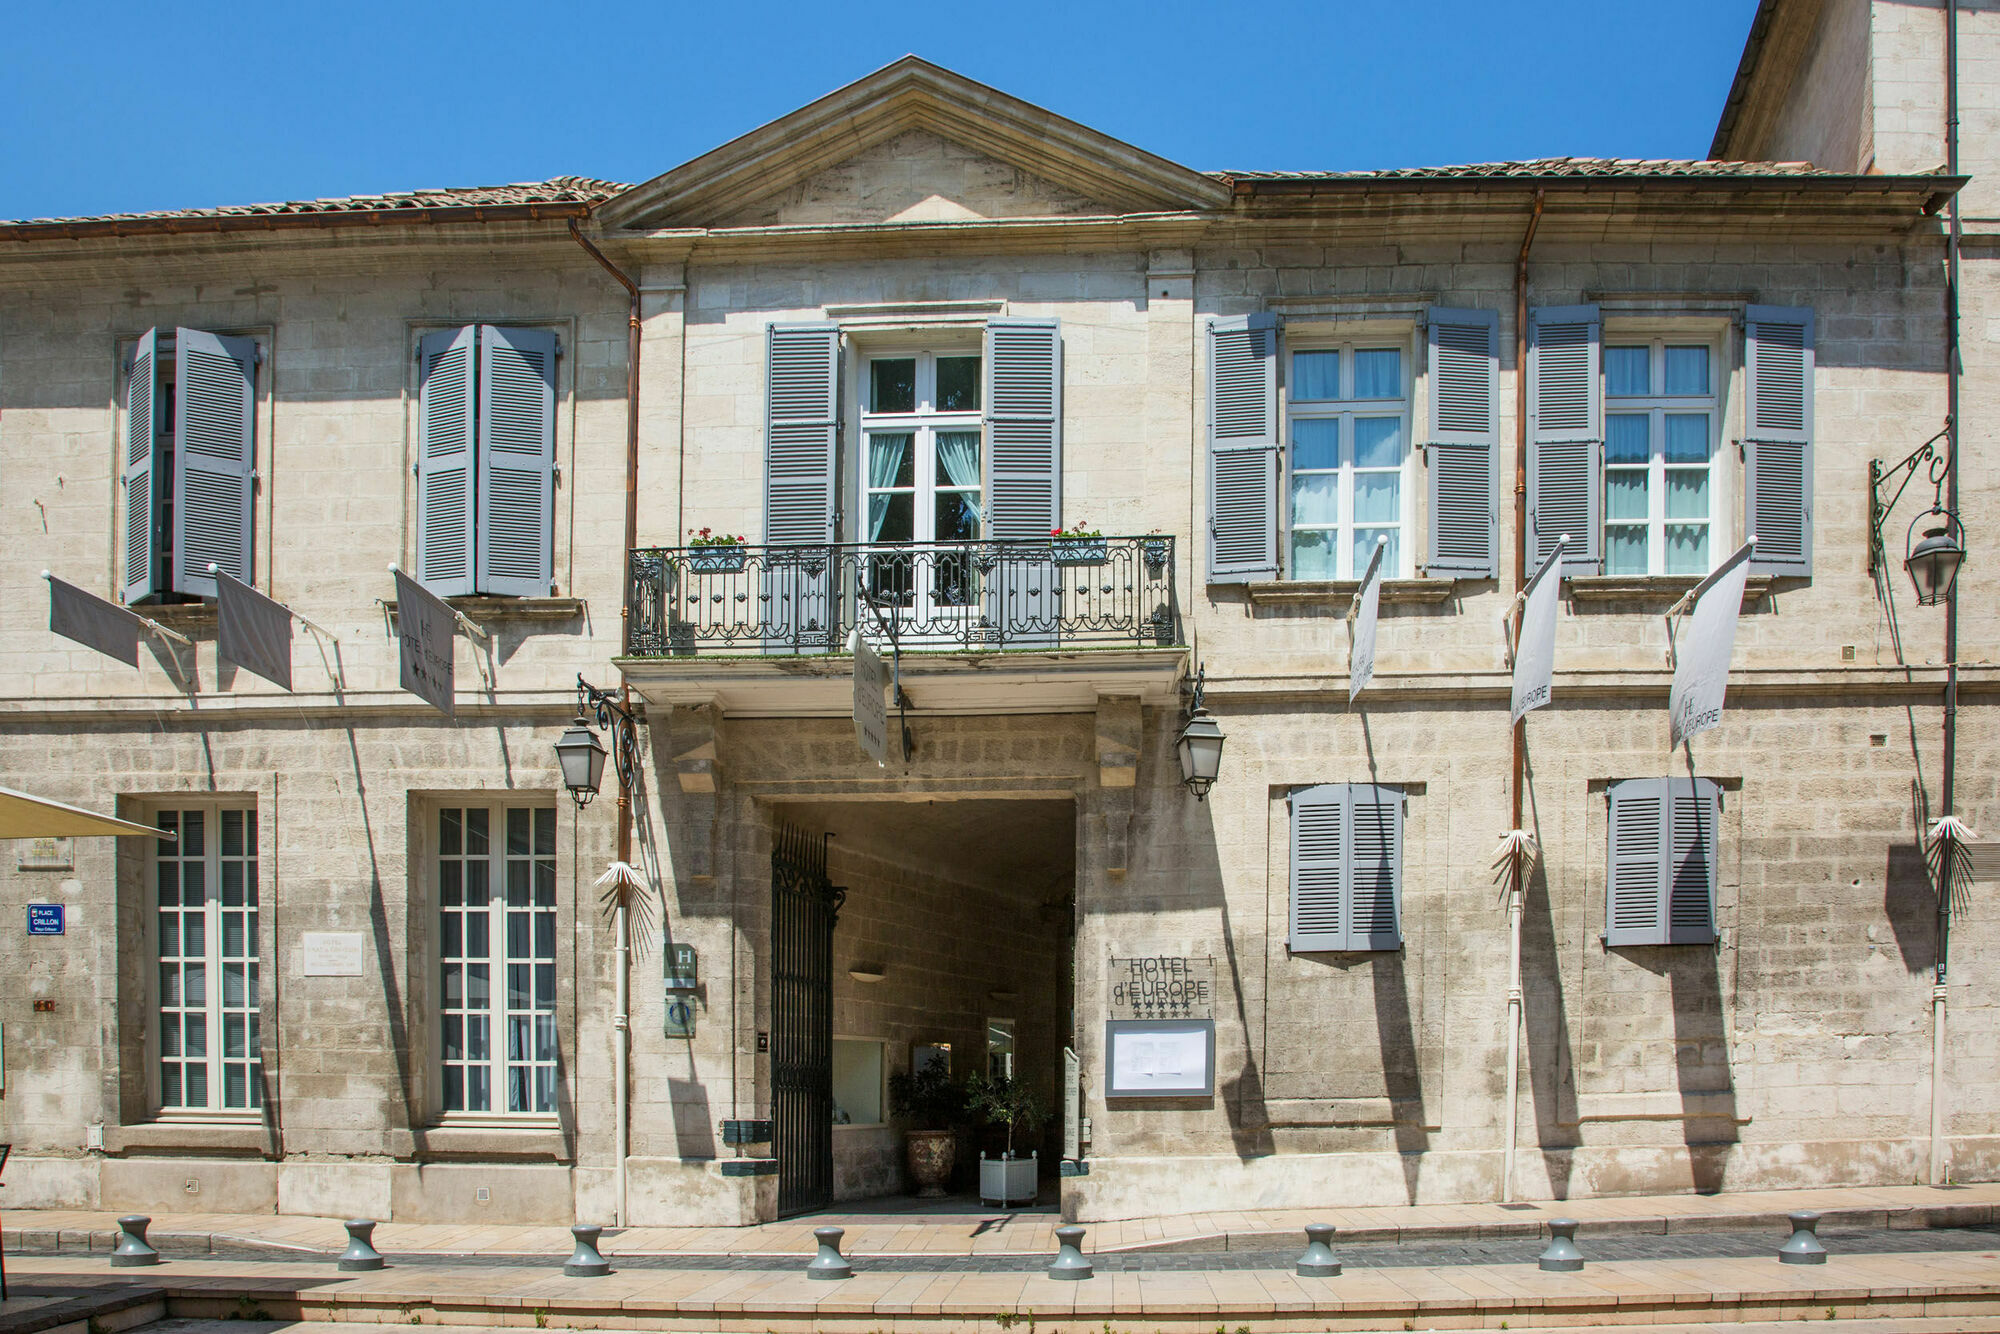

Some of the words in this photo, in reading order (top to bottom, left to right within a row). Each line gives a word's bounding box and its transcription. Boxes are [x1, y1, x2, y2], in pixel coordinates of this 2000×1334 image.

[678, 950, 692, 964] H
[1130, 957, 1192, 973] HOTEL
[1113, 981, 1208, 997] d'EUROPE
